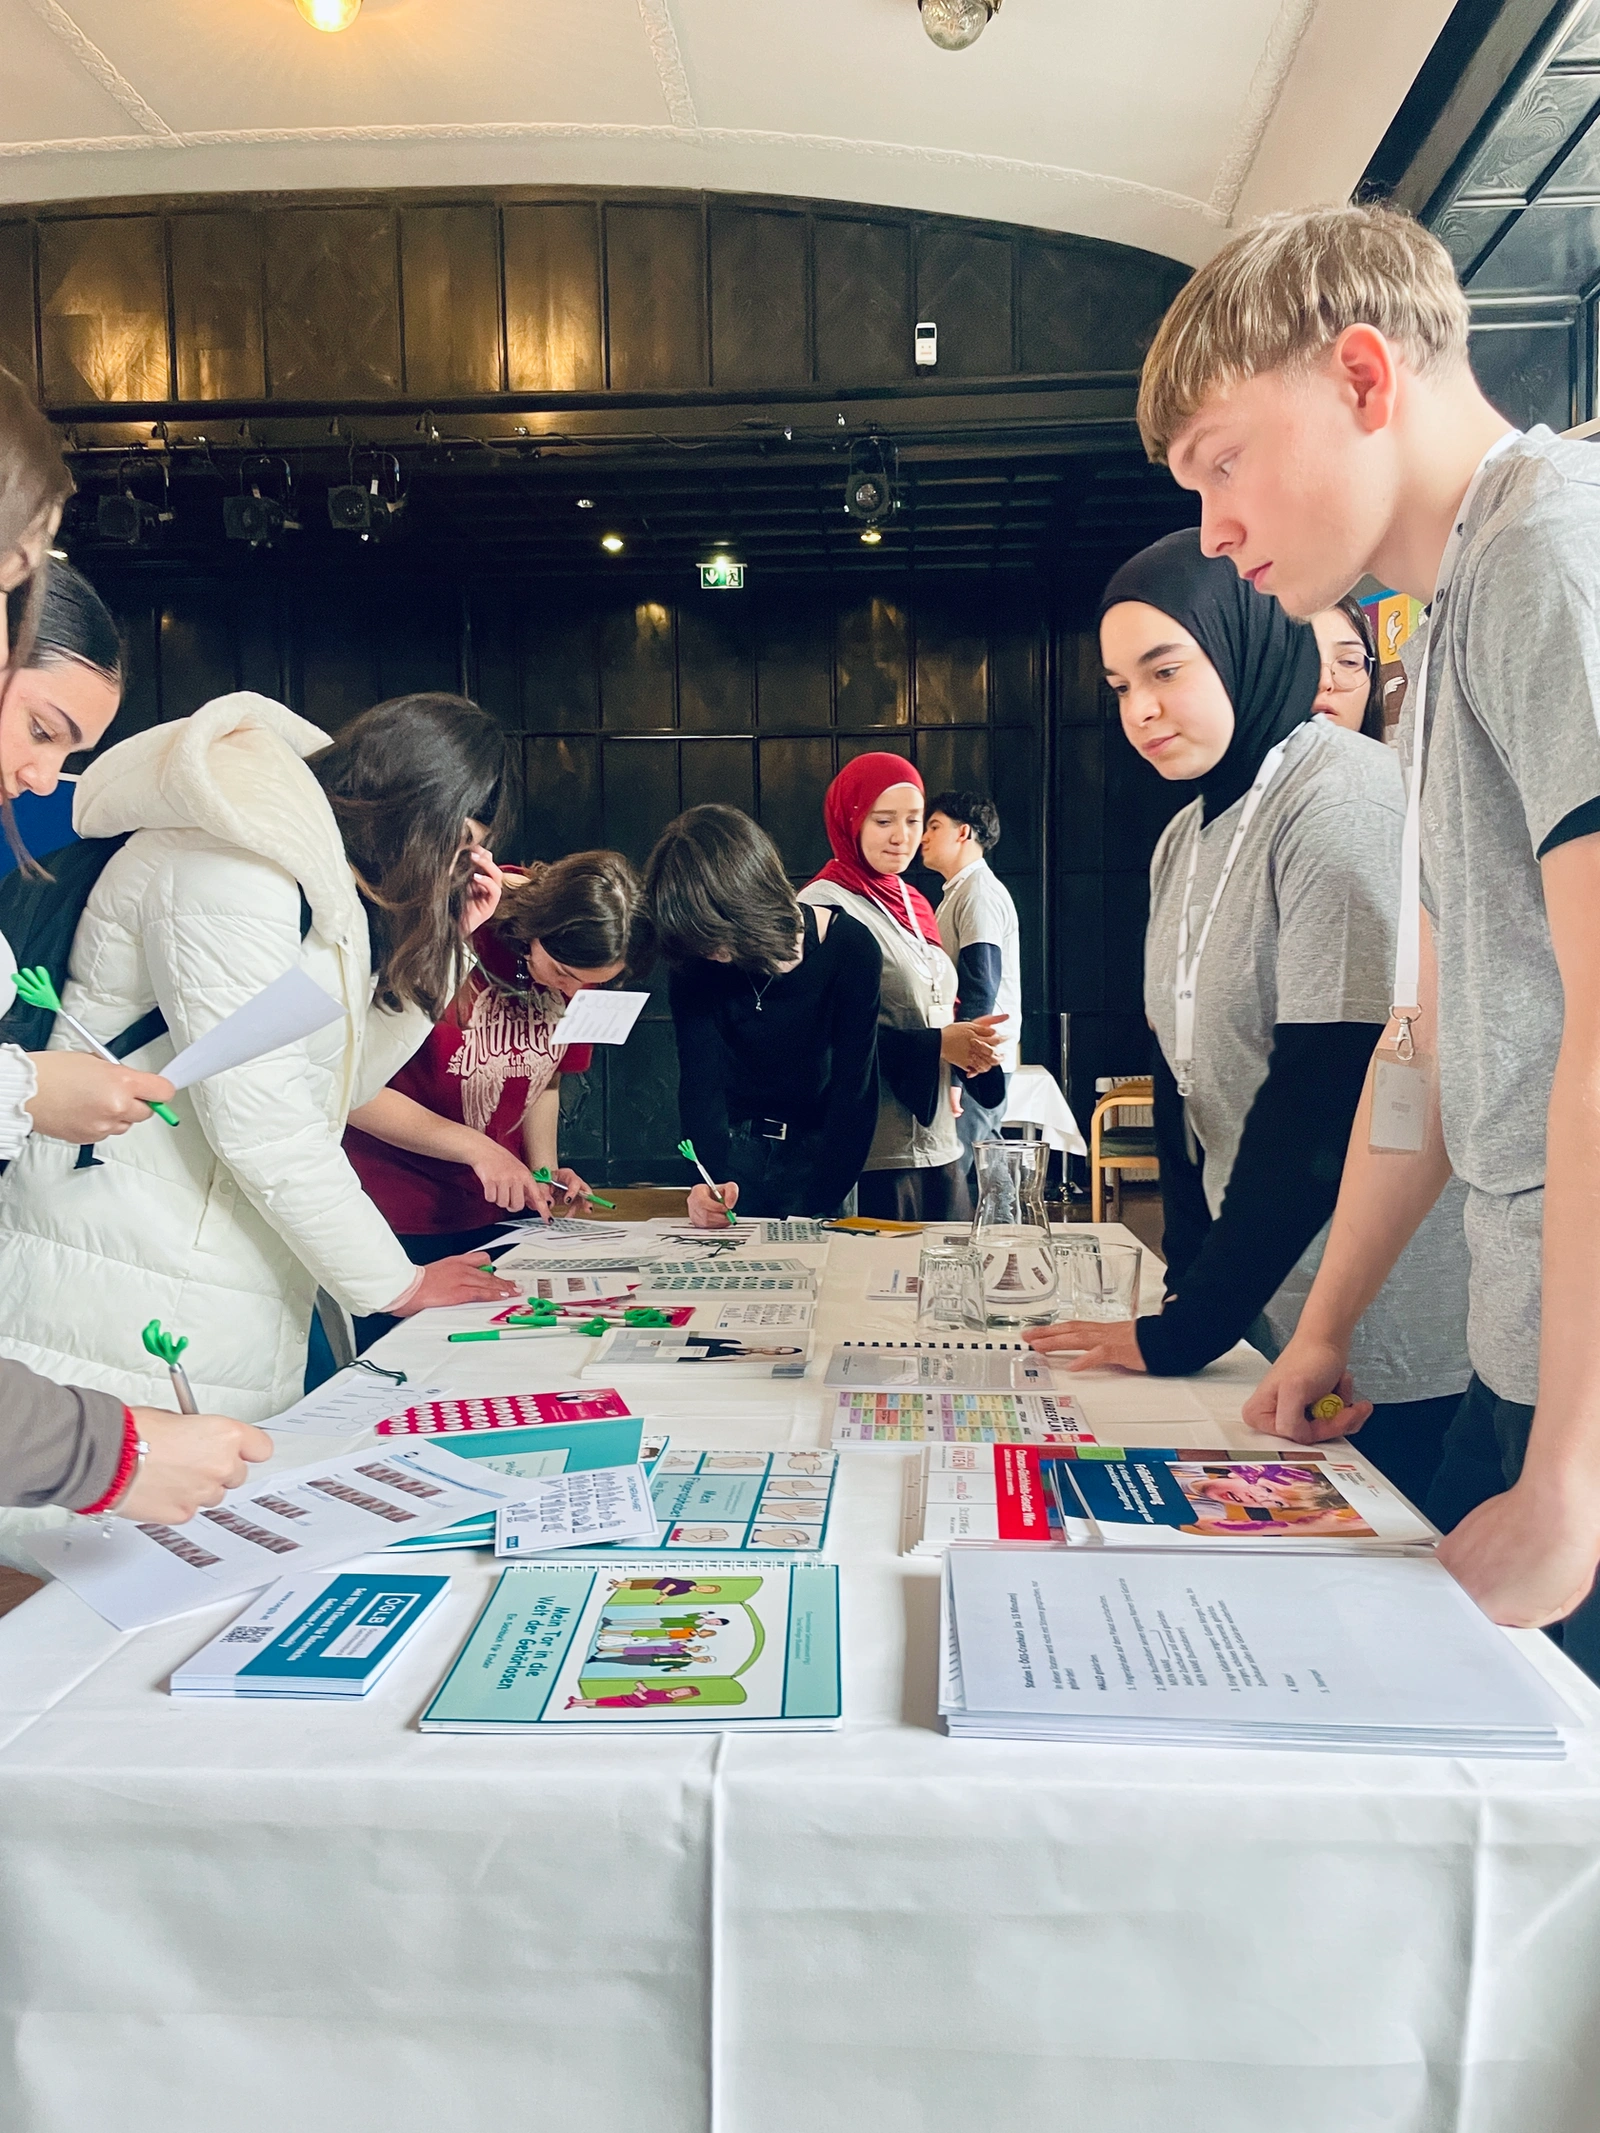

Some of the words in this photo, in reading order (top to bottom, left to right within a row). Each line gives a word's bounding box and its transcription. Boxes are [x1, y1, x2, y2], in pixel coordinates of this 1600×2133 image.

[1041, 1397, 1066, 1432] JAHRESPLAN
[1061, 1417, 1078, 1431] 2025
[952, 1451, 965, 1467] WIEN
[1135, 1464, 1164, 1505] Frühförderung
[670, 1478, 700, 1517] Fingeralphabet
[700, 1491, 716, 1503] Mein
[1023, 1512, 1035, 1526] Wien
[532, 1596, 555, 1616] Welt
[548, 1607, 570, 1627] Mein
[496, 1622, 512, 1642] Sachbuch
[524, 1620, 543, 1634] der
[540, 1631, 561, 1646] Tor
[1017, 1630, 1030, 1664] ÖGS-Crashkurs
[483, 1654, 497, 1668] Kinder
[533, 1651, 552, 1659] in
[498, 1639, 535, 1689] Gehörlosen
[526, 1663, 547, 1676] die
[1160, 1659, 1172, 1672] NAME
[1189, 1660, 1202, 1672] NAME
[1025, 1671, 1035, 1688] Station
[1095, 1676, 1106, 1690] HALLO
[1167, 1673, 1178, 1685] MEIN
[1196, 1674, 1208, 1686] MEIN
